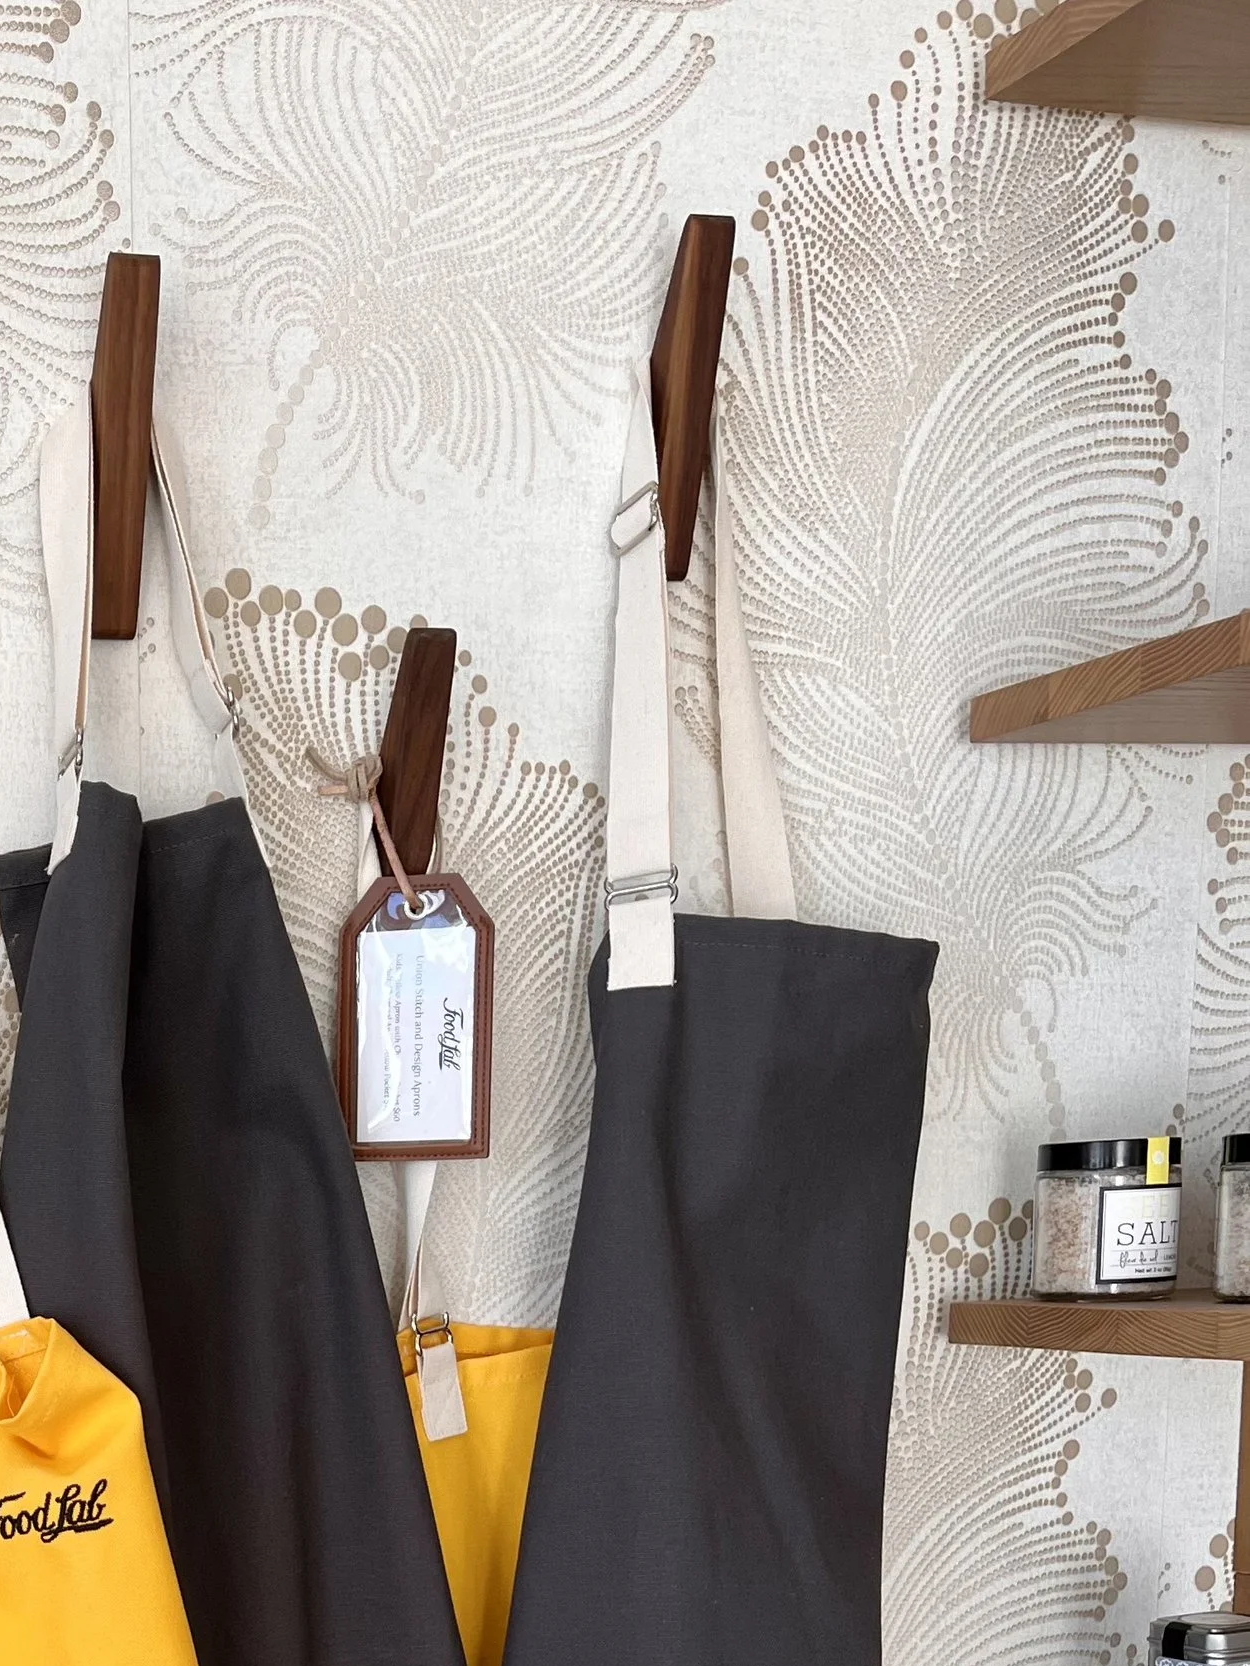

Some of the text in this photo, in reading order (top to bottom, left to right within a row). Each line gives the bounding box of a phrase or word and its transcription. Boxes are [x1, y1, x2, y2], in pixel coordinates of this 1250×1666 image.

[394, 1000, 402, 1024] Apron
[414, 988, 425, 1019] Stitch
[413, 1021, 424, 1040] and
[411, 1043, 423, 1078] Design
[411, 1080, 423, 1117] Aprons
[1117, 1220, 1178, 1246] SALT
